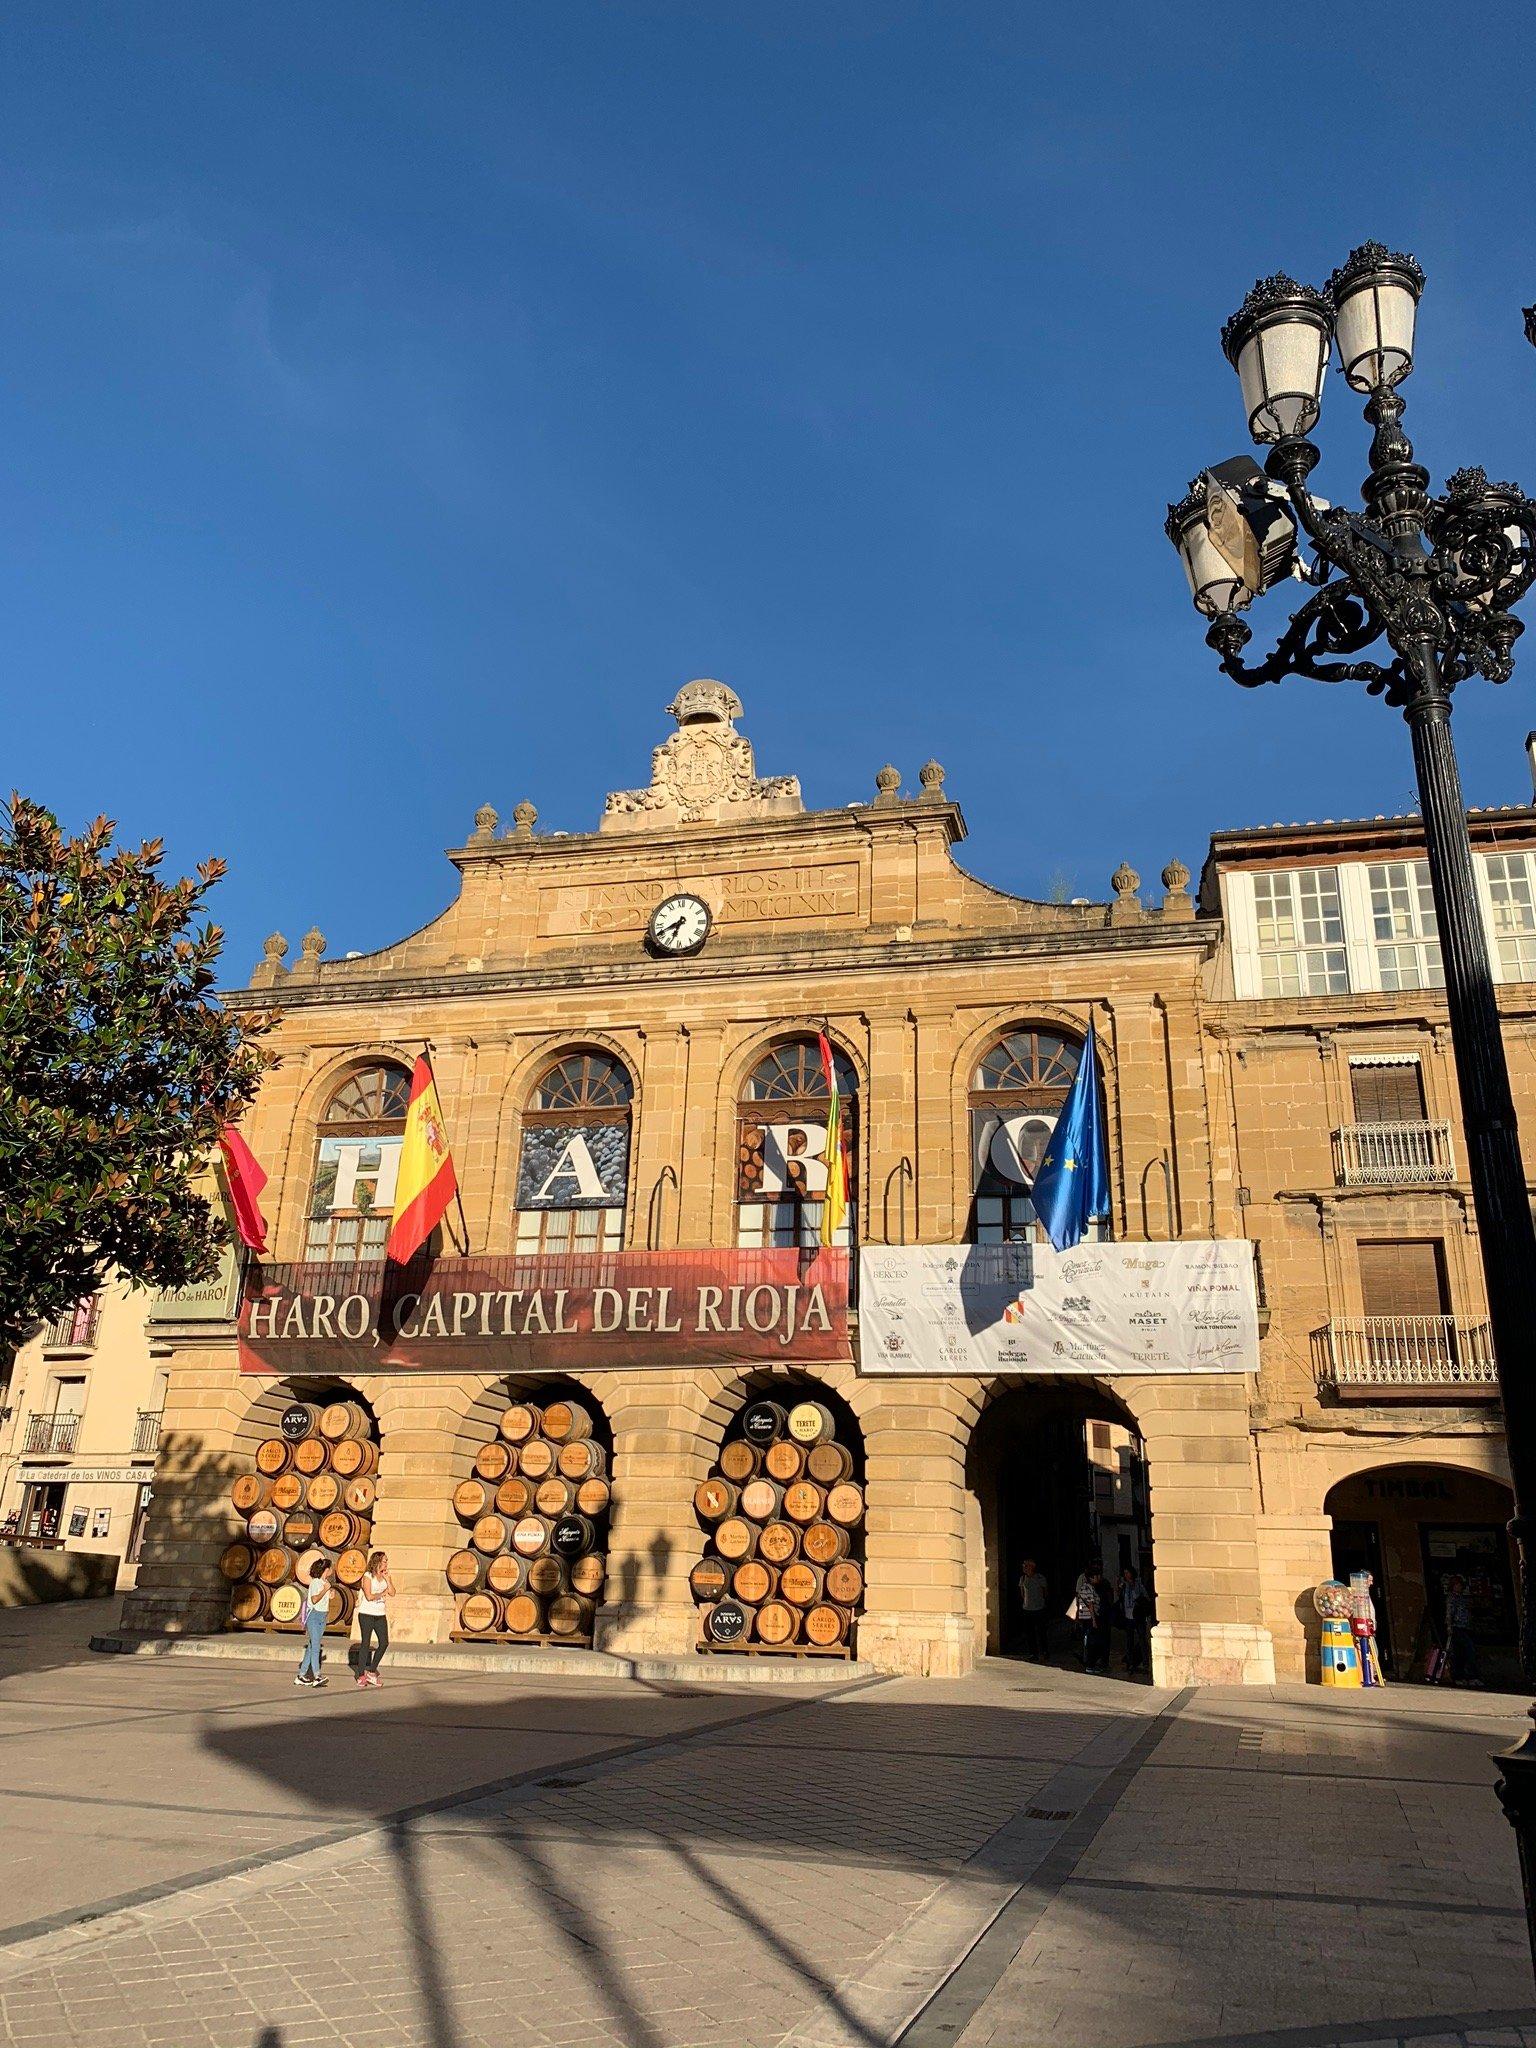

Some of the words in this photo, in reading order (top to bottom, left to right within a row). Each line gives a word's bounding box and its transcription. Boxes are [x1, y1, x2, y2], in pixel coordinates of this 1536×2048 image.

[754, 1123, 829, 1194] R
[531, 1133, 611, 1200] A
[1121, 1257, 1165, 1270] Muga
[873, 1270, 908, 1279] BERCEO
[1187, 1283, 1208, 1292] VIÑA
[1209, 1284, 1241, 1292] POMAL
[195, 1285, 227, 1301] HARO!
[1122, 1291, 1170, 1299] AKUTAIN
[247, 1295, 380, 1350] HARO,
[397, 1288, 580, 1339] CAPITAL
[591, 1286, 682, 1335] DEL
[695, 1282, 835, 1345] RIOJA
[1128, 1317, 1168, 1325] MASET
[939, 1347, 968, 1355] CARLOS
[1130, 1351, 1170, 1361] TERETE
[26, 1471, 35, 1480] La
[71, 1470, 80, 1480] de
[82, 1470, 94, 1480] los
[97, 1470, 121, 1480] VINOS
[125, 1470, 148, 1480] CASA
